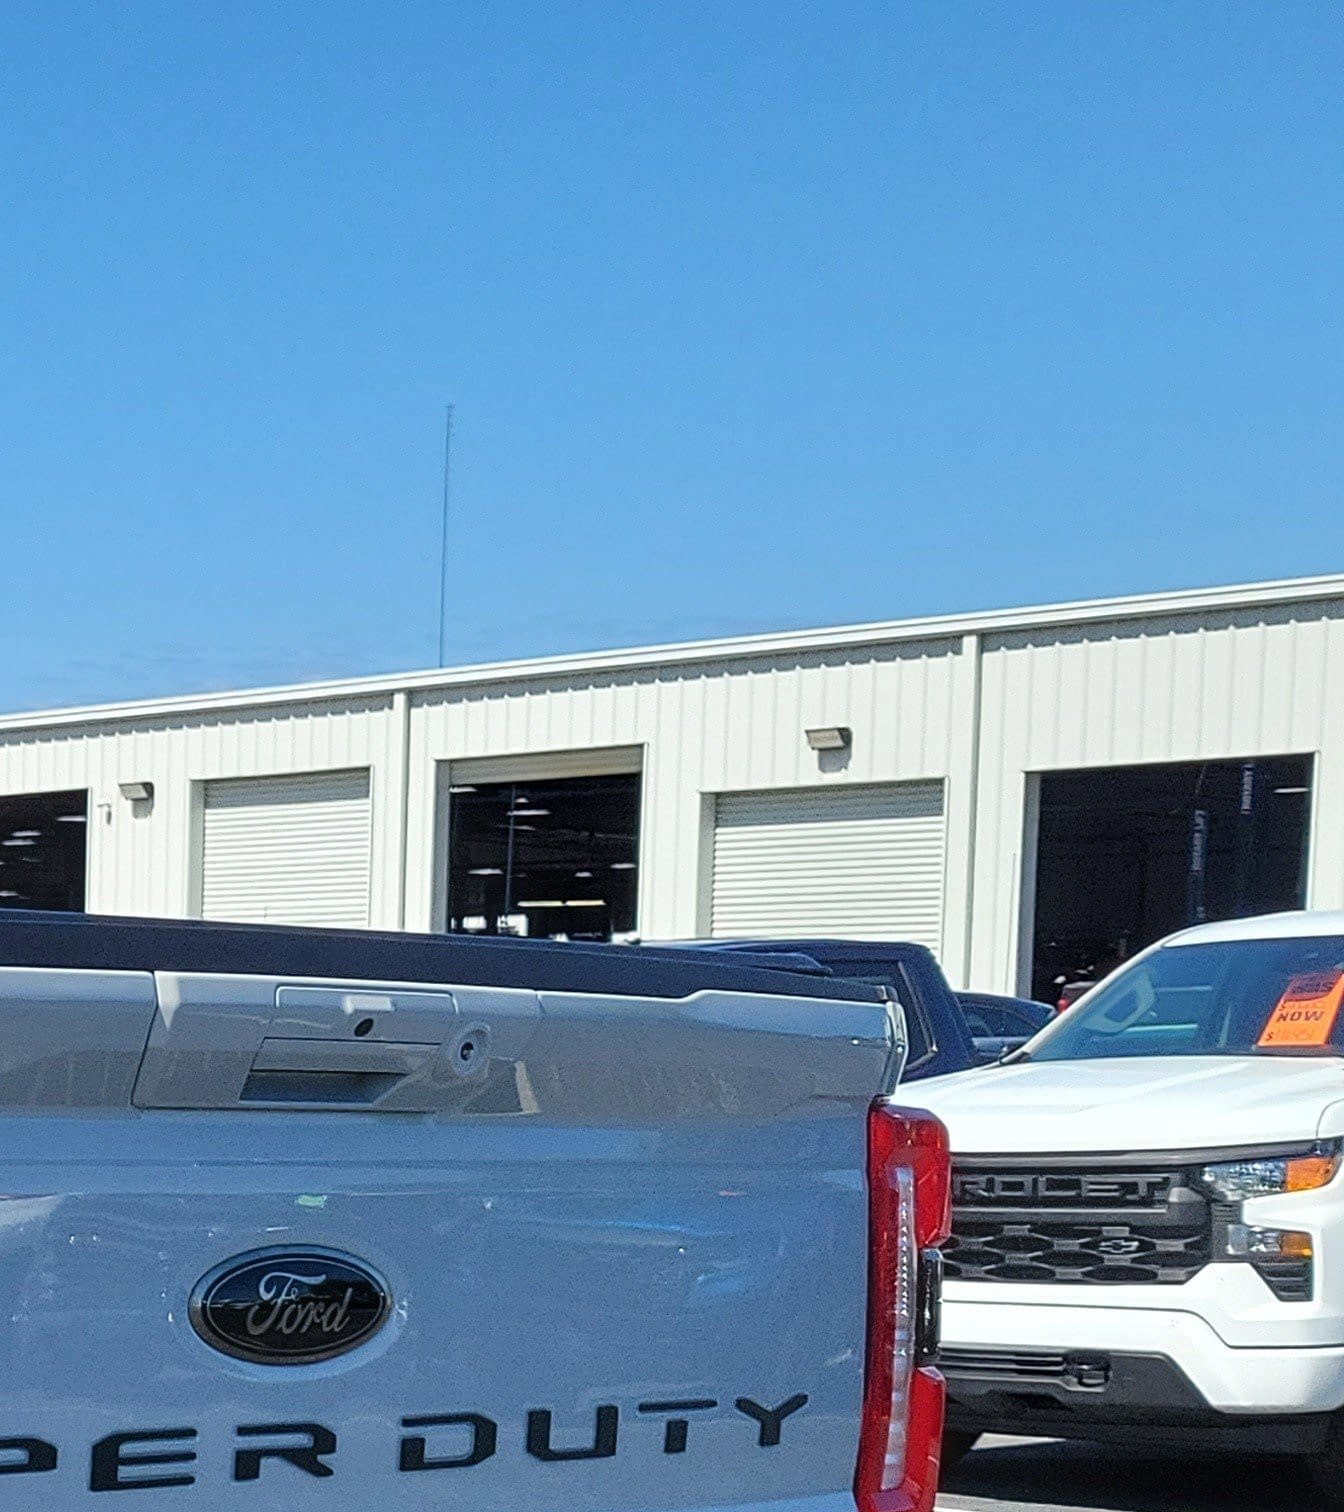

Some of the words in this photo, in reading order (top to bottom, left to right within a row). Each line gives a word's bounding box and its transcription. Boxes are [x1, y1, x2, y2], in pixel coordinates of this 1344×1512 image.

[1276, 1010, 1326, 1023] NOW
[953, 1174, 1168, 1201] ROLET
[245, 1271, 354, 1336] Ford
[399, 1393, 810, 1472] DUTY
